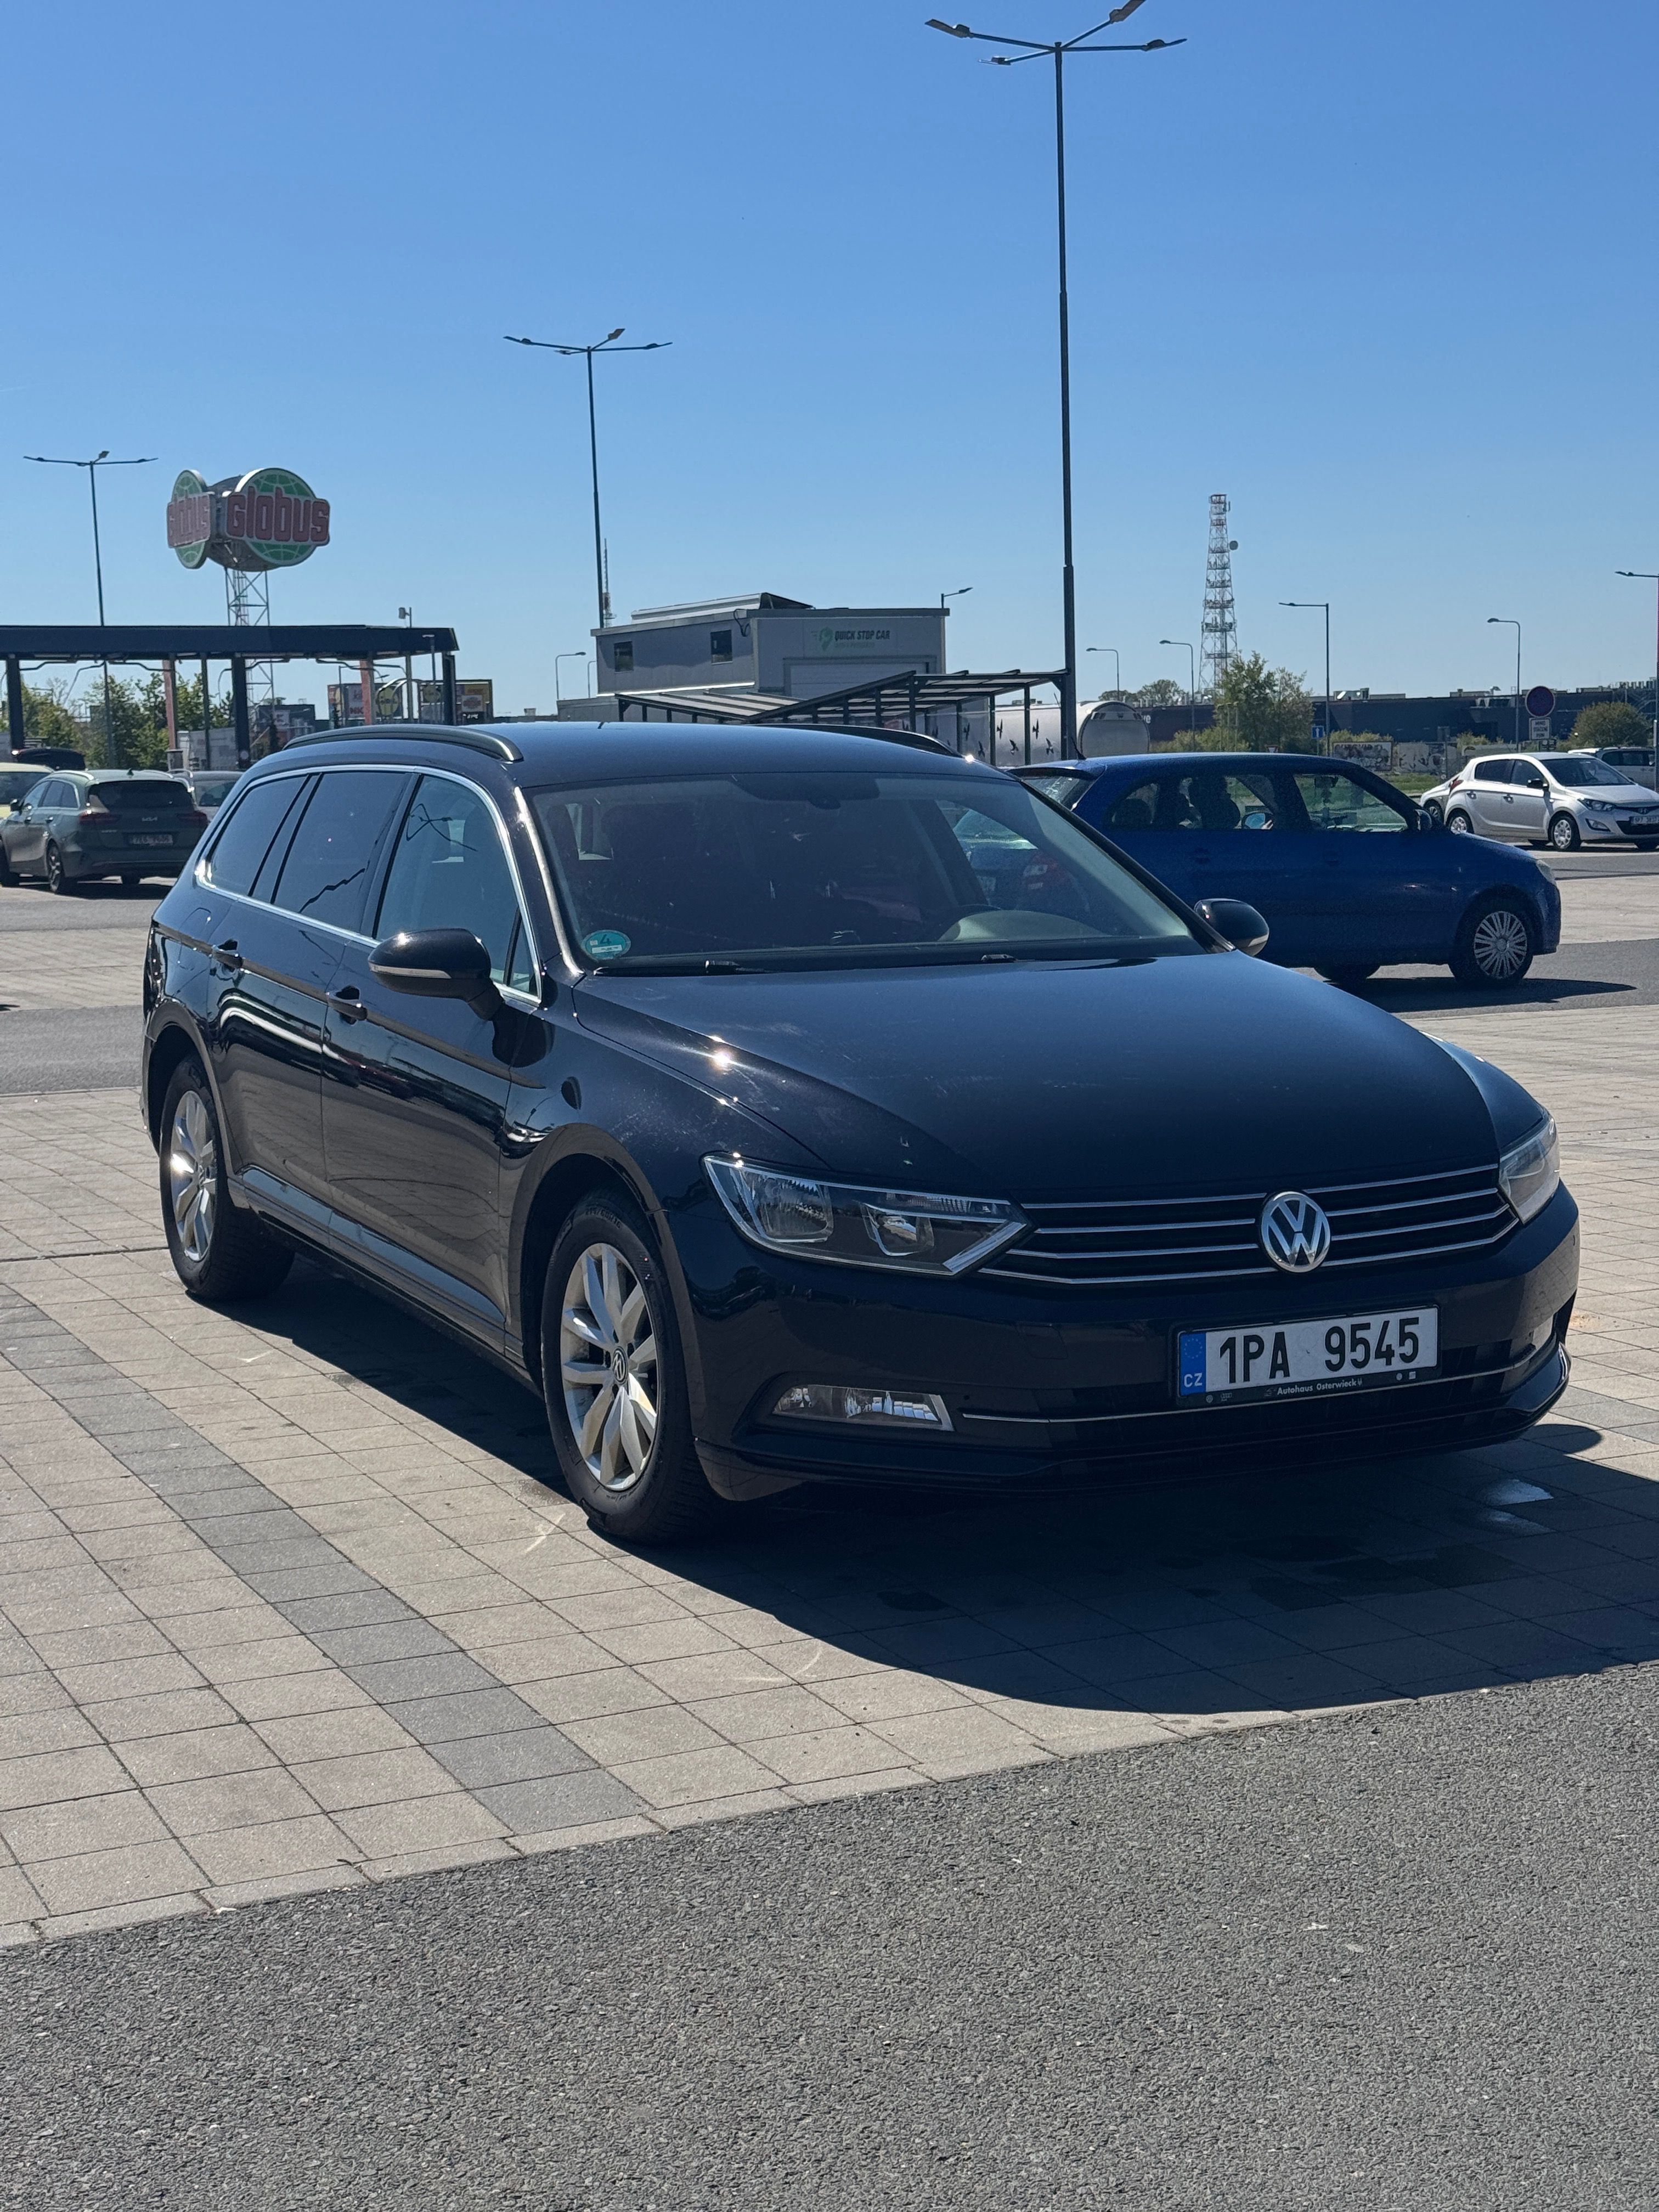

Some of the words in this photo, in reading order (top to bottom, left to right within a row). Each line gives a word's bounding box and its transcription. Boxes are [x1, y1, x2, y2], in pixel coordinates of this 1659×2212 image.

[834, 630, 856, 641] QUICK
[857, 630, 874, 640] STOP
[876, 630, 890, 640] CAR
[600, 934, 612, 944] 4
[1220, 1331, 1290, 1384] 1PA
[1324, 1317, 1420, 1373] 9545
[1184, 1373, 1203, 1388] CZ
[1277, 1384, 1313, 1396] Autohaus
[1316, 1378, 1357, 1391] Osterwieck
